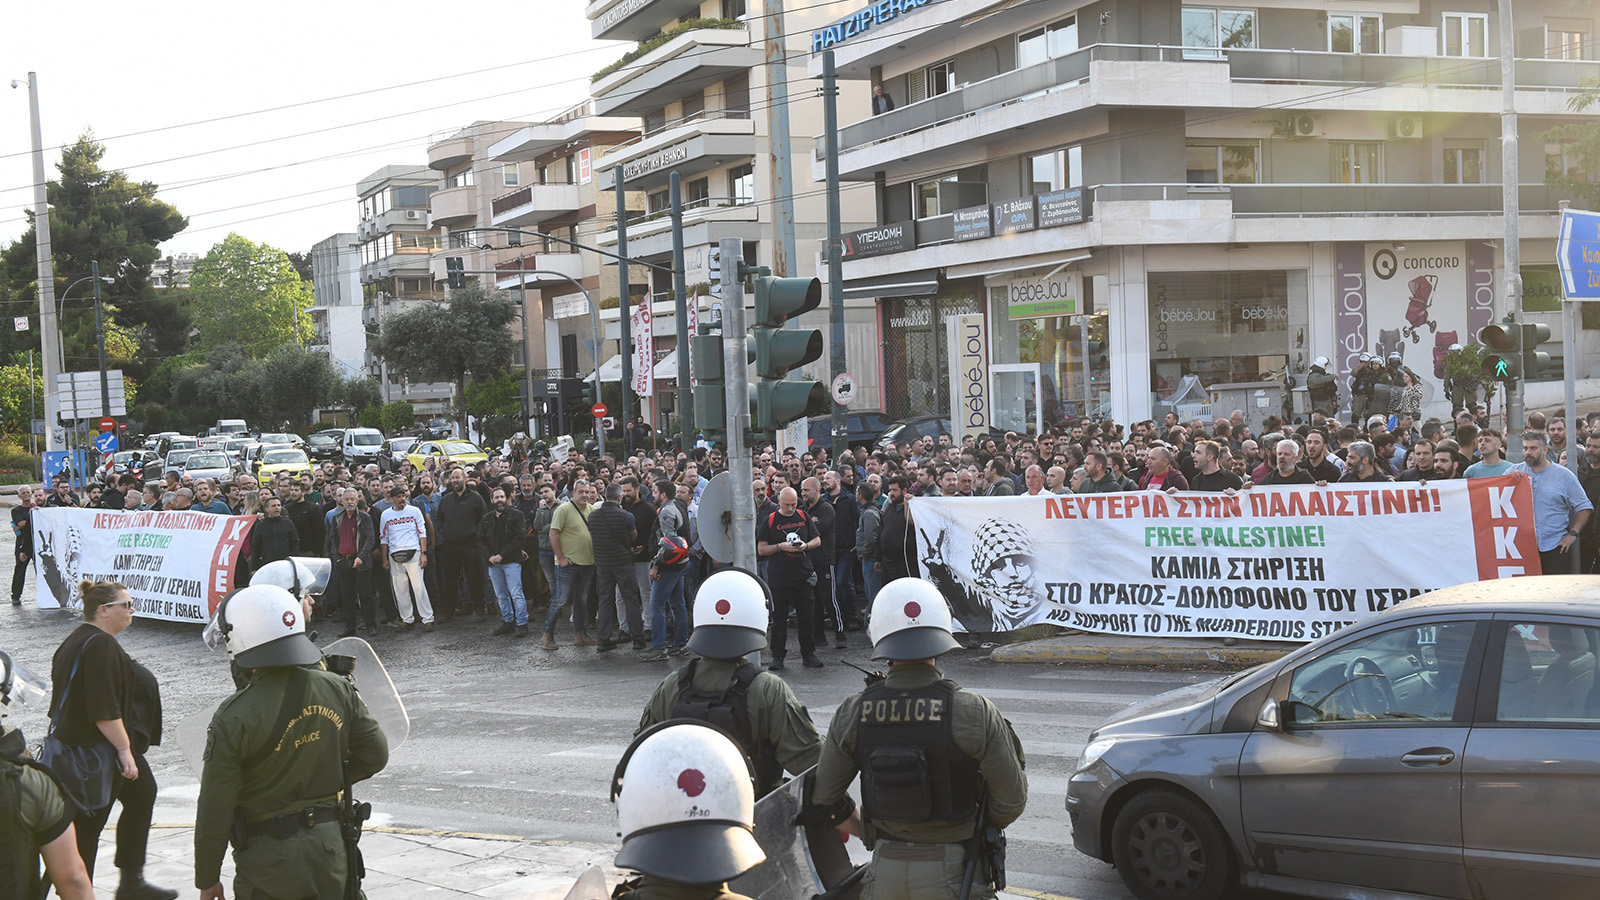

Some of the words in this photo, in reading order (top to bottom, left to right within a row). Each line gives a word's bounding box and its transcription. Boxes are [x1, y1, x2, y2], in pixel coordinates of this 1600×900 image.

[1011, 200, 1032, 213] Βλάχου
[1011, 212, 1027, 223] ΩΡΛ
[857, 226, 902, 244] ΥΠΕΡΔΟΜΗ
[1403, 256, 1459, 270] CONCORD
[1010, 277, 1068, 303] bébéjou
[1241, 305, 1288, 320] bébéjo
[963, 324, 985, 428] bébéjou
[1045, 494, 1170, 519] ΛΕΥΤΕΡΙΑ
[1172, 495, 1242, 518] ΣΤΗΝ
[1248, 488, 1441, 518] ΠΑΛΑΙΣΤΙΝΗ!
[154, 512, 219, 532] ΠΑΛΑΙΣΤΙΝΗ!
[117, 533, 133, 548] FREE
[134, 533, 173, 549] PLESTINE!
[1145, 526, 1197, 547] FREE
[1200, 525, 1326, 547] PALESTINE!
[1151, 556, 1222, 579] ΚΑΜΙΑ
[1227, 557, 1325, 581] ΣΤΗΡΙΞΗ
[150, 576, 167, 594] ΤΟΥ
[167, 577, 202, 599] ΙΣΡΑΗΛ
[1045, 582, 1082, 604] ΣΤΟ
[1089, 582, 1308, 610] ΚΡΑΤΟΣ-ΔΟΛΟΦΟΝΟ
[1313, 588, 1357, 612] ΤΟΥ
[1365, 588, 1441, 612] ΙΣΡ
[142, 598, 162, 615] STATE
[164, 601, 173, 616] OF
[175, 601, 204, 619] ISRAEL
[1045, 608, 1071, 622] NO
[1072, 611, 1139, 632] SUPPORT
[1143, 613, 1161, 632] TO
[1164, 614, 1193, 632] THE
[1196, 616, 1306, 639] MURDEROUS
[1310, 620, 1358, 639] STA
[302, 704, 344, 731] ΑΣΤΥΝΟΜΙΑ
[860, 698, 944, 723] POLICE
